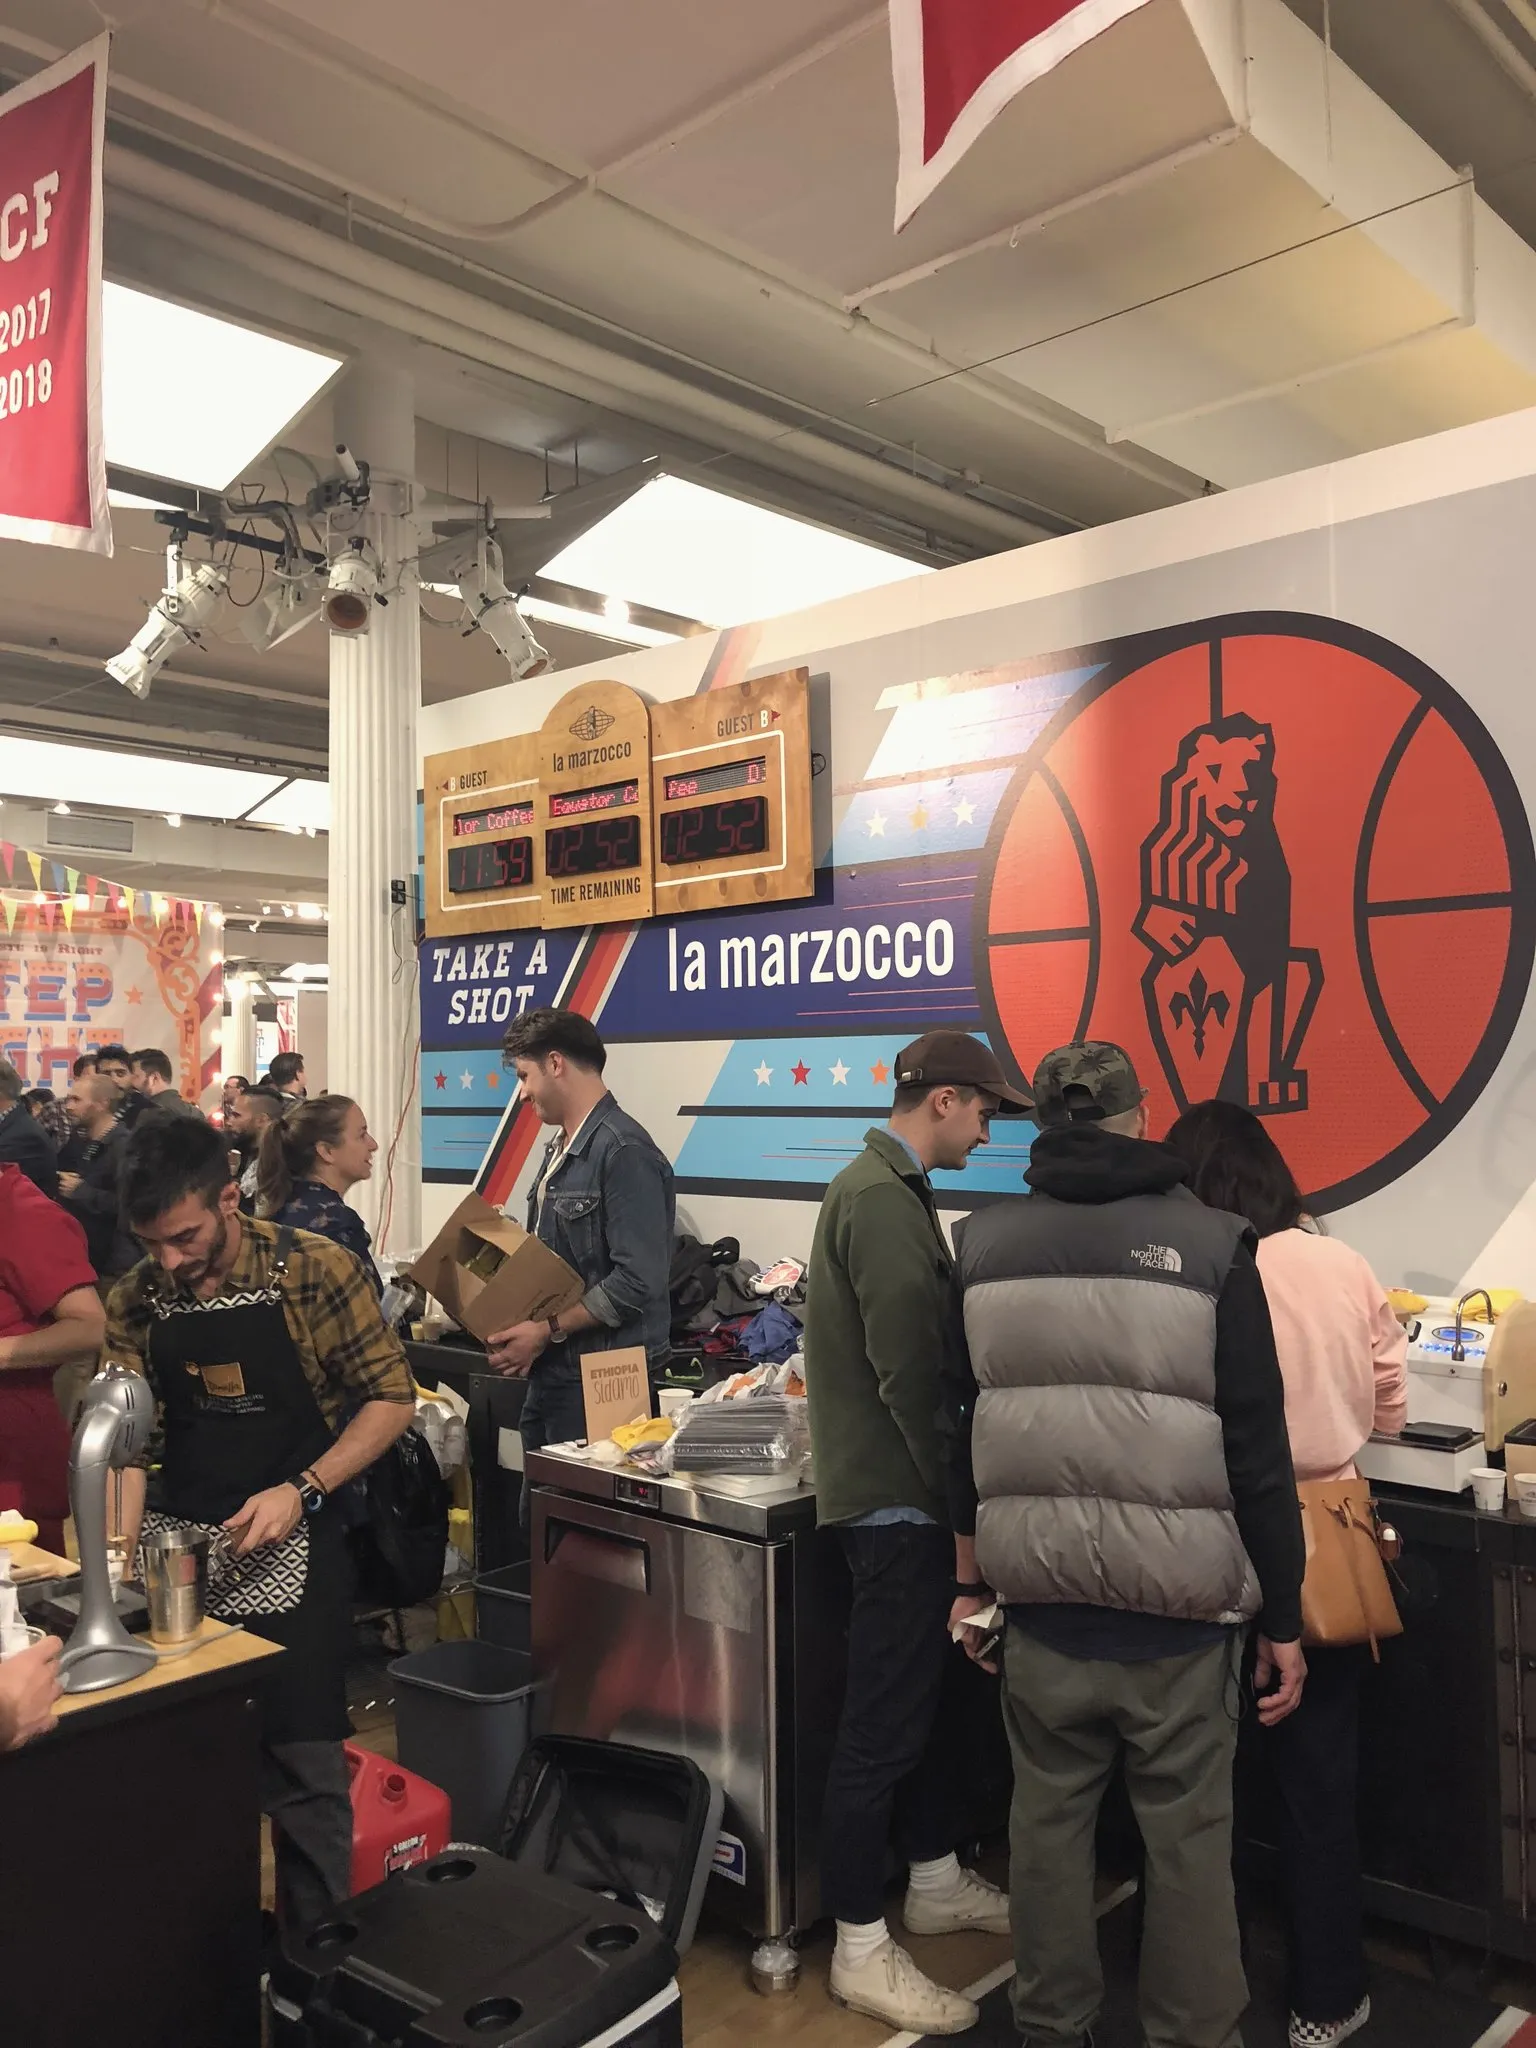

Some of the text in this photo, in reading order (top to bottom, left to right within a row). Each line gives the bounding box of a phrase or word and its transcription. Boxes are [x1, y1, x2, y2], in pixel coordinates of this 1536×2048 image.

[0, 288, 51, 354] 2017
[0, 358, 53, 420] 2018
[717, 713, 754, 737] GUEST
[553, 742, 631, 772] la marzocco
[460, 770, 488, 790] GUEST
[551, 877, 641, 905] TIME REMAINING
[433, 938, 548, 983] TAKE A
[668, 918, 955, 992] la marzocco
[447, 985, 535, 1025] SHOT
[1131, 1249, 1165, 1262] NORTH
[1147, 1244, 1167, 1255] THE
[1140, 1259, 1164, 1270] FACE
[590, 1363, 639, 1379] ETHIOPIA
